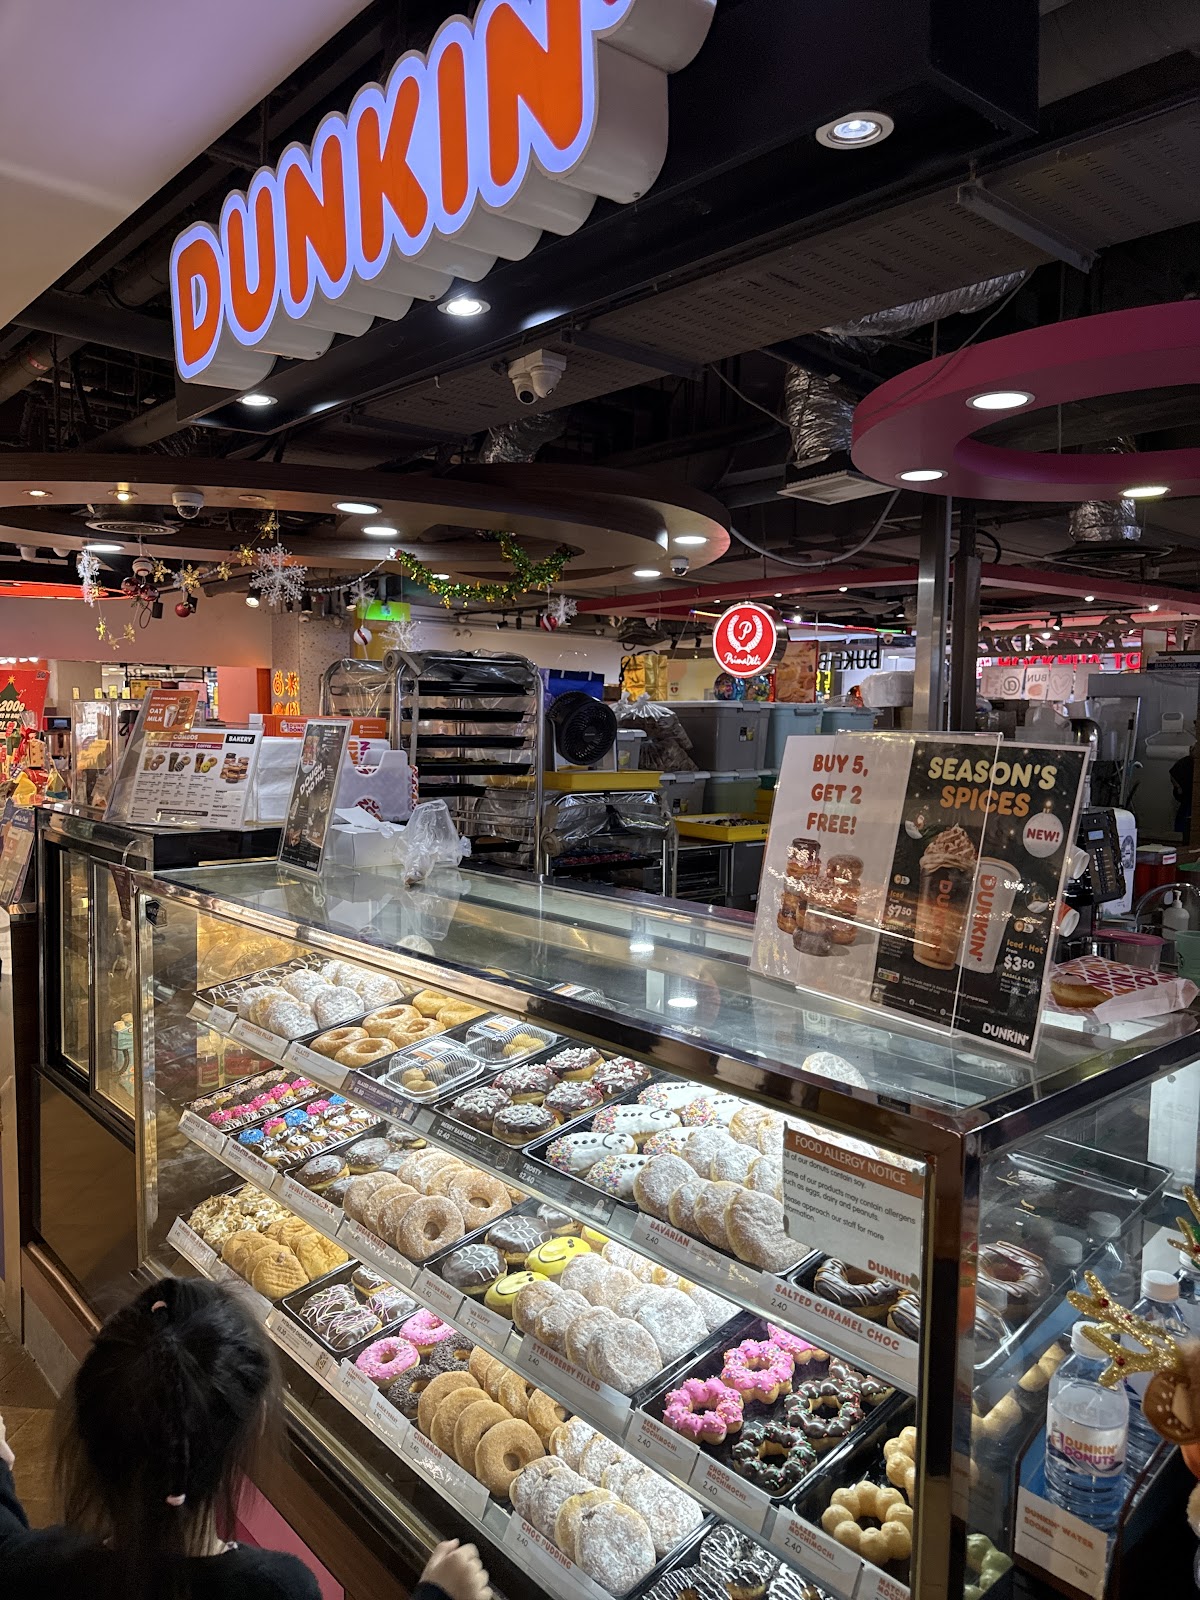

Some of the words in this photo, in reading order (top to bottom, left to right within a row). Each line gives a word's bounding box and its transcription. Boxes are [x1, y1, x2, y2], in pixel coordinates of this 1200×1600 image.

[176, 0, 617, 367] DUNKIN
[229, 735, 253, 743] BAKERY
[812, 754, 849, 773] BUY
[851, 755, 869, 777] 5,
[927, 756, 1058, 790] SEASON'S
[300, 763, 322, 795] DOUGH
[305, 783, 316, 797] HO
[315, 768, 326, 786] HO!
[811, 783, 847, 803] GET
[850, 785, 863, 805] 2
[939, 785, 1031, 817] SPICES
[806, 812, 857, 835] FREE!
[1026, 828, 1061, 843] NEW!
[890, 890, 904, 899] Iced
[968, 874, 997, 962] DUNKIN'
[1007, 939, 1024, 949] Iced
[1029, 944, 1044, 955] Hot
[1001, 972, 1021, 981] MASALA
[982, 1022, 1030, 1046] DUNKIN'
[436, 1128, 450, 1140] $2.40
[440, 1120, 454, 1134] MERRY
[453, 1126, 477, 1142] RASPBERRY
[523, 1162, 542, 1176] FROSTY
[795, 1135, 822, 1154] FOOD
[824, 1146, 866, 1168] ALLERGY
[867, 1161, 907, 1185] NOTICE
[798, 1157, 808, 1165] our
[809, 1160, 829, 1174] donuts
[830, 1170, 852, 1183] contain
[518, 1172, 535, 1184] $2.40
[797, 1183, 805, 1191] as
[805, 1186, 821, 1199] eggs,
[823, 1192, 838, 1206] dairy
[839, 1200, 851, 1210] and
[852, 1204, 880, 1221] peanuts.
[807, 1177, 817, 1185] our
[817, 1181, 844, 1197] products
[844, 1190, 858, 1204] may
[859, 1199, 883, 1213] contain
[885, 1207, 916, 1224] allergens
[784, 1204, 816, 1222] nformation.
[802, 1202, 830, 1219] approach
[831, 1213, 842, 1222] our
[843, 1218, 856, 1229] staff
[857, 1223, 866, 1233] for
[867, 1229, 885, 1240] more
[355, 1224, 371, 1238] SUGAR
[369, 1233, 387, 1249] RAISED
[645, 1233, 659, 1245] 2.40
[649, 1219, 690, 1248] BAVARIAN
[422, 1287, 432, 1298] 2.40
[770, 1298, 788, 1312] 2.40
[466, 1318, 477, 1329] 2.40
[476, 1312, 491, 1325] HAPPY
[774, 1283, 812, 1308] SALTED
[814, 1302, 863, 1335] CARAMEL
[866, 1327, 900, 1351] CHOC
[527, 1354, 540, 1367] 2.40
[532, 1342, 576, 1376] STRAWBERRY
[576, 1371, 601, 1393] FILLED
[642, 1418, 661, 1433] BERRY
[413, 1431, 443, 1459] CINNAMON
[637, 1434, 651, 1449] 2.40
[641, 1423, 678, 1451] MOCHIMOCHI
[1065, 1436, 1117, 1454] DUNKIN'
[1064, 1447, 1115, 1465] DONUTS
[708, 1464, 730, 1482] CHOCO
[702, 1481, 717, 1496] 2.40
[706, 1470, 747, 1501] MOCHIMOCHI
[516, 1534, 528, 1547] 2.40
[790, 1519, 817, 1540] GLAZED
[1062, 1526, 1094, 1549] WATER
[520, 1522, 541, 1543] CHOC
[541, 1537, 572, 1570] PUDDING
[784, 1537, 801, 1554] 2.40
[788, 1525, 835, 1561] MOCHIMOCHI
[877, 1585, 898, 1600] MOC
